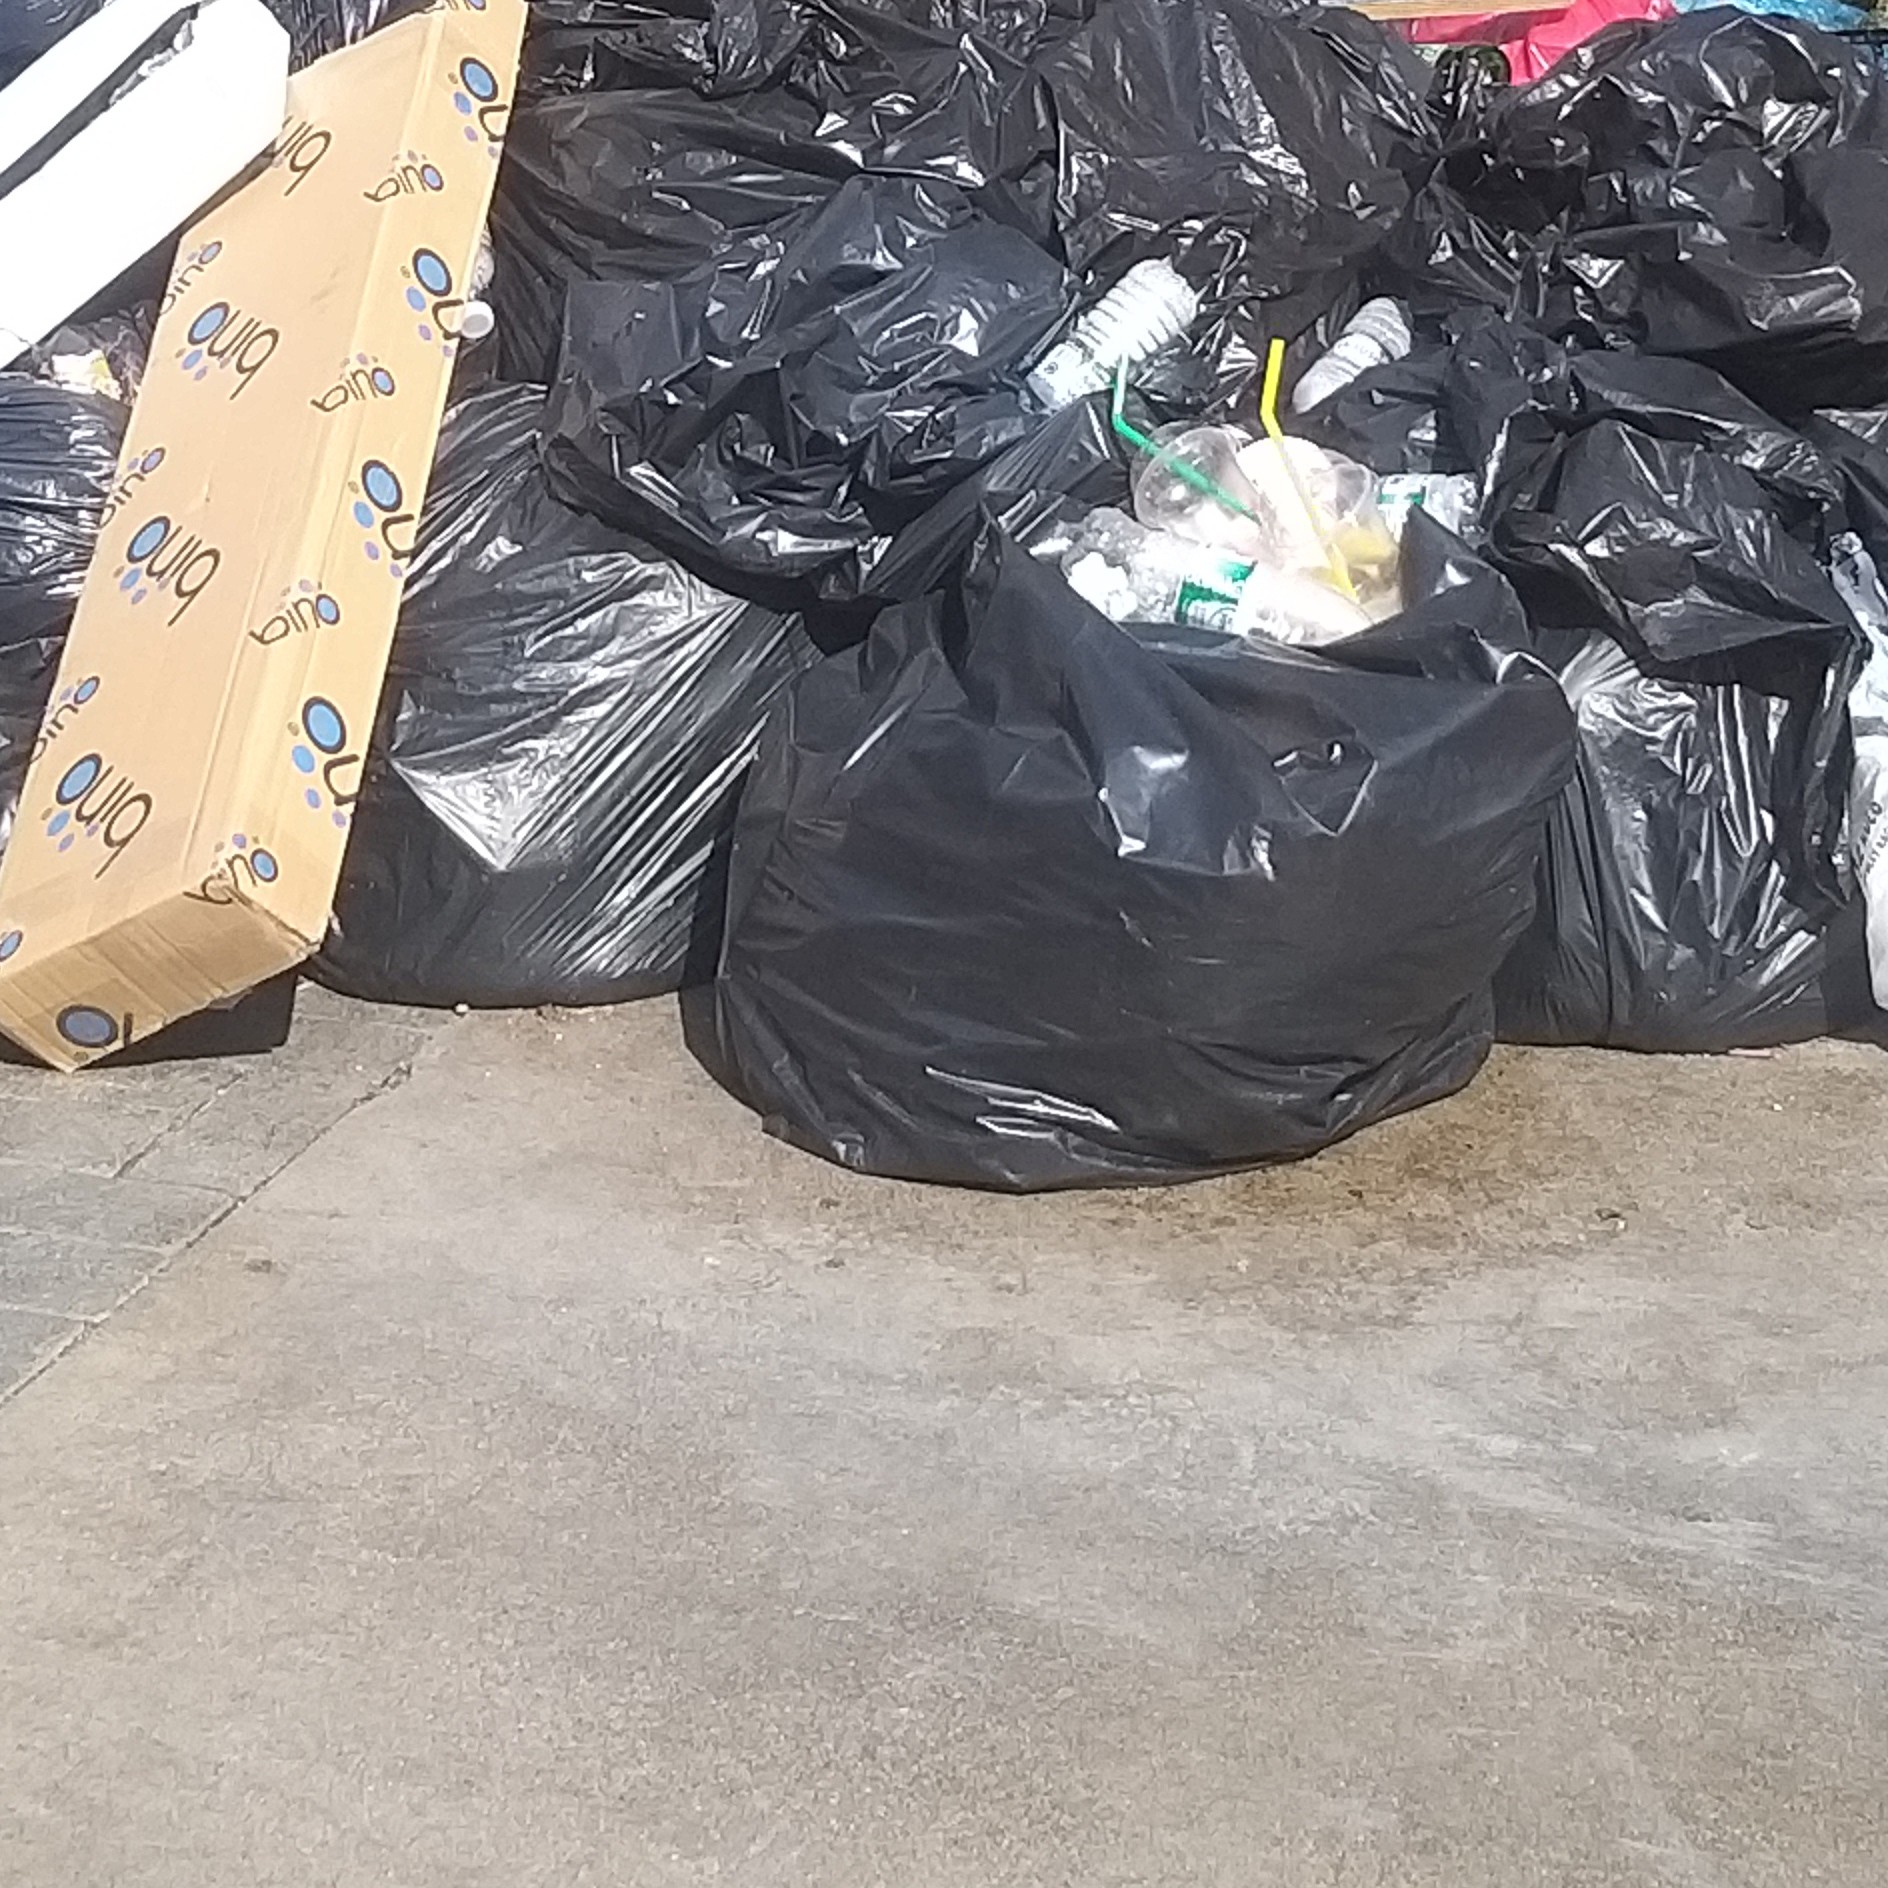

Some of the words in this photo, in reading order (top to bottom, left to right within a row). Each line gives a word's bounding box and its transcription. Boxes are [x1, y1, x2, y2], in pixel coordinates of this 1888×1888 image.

[187, 301, 280, 400] bino
[126, 515, 221, 626] bino
[55, 752, 154, 880] bino
